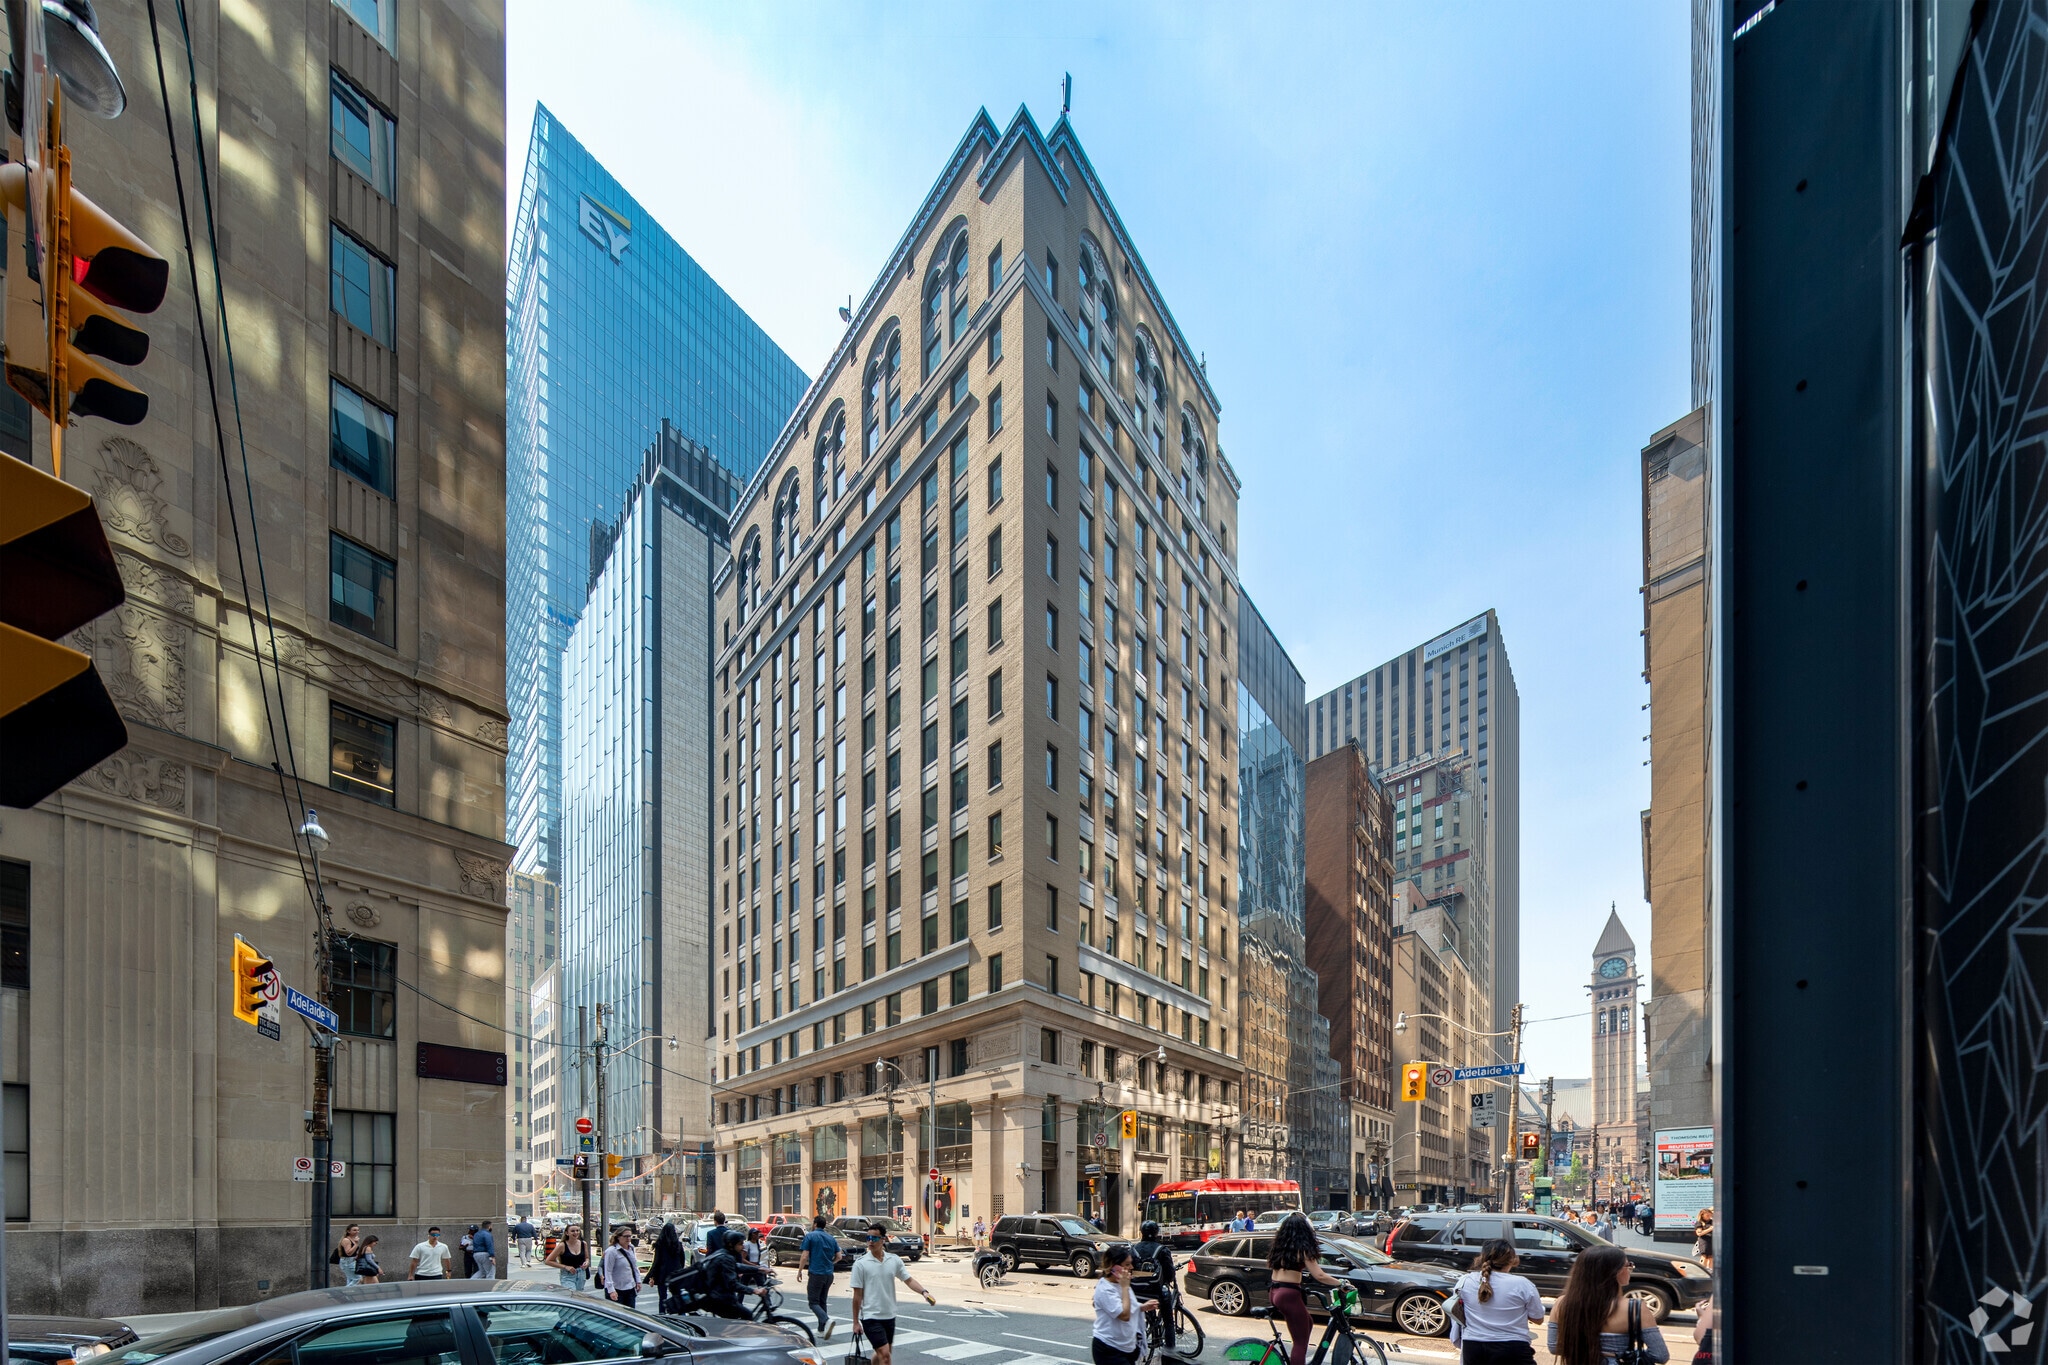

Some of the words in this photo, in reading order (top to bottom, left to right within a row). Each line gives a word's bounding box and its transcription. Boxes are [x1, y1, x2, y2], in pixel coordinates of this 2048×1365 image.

[580, 195, 631, 263] EY
[1428, 641, 1455, 658] Munich
[1456, 634, 1466, 643] RE
[290, 991, 326, 1021] Adelaide
[330, 1013, 336, 1028] W
[1458, 1067, 1502, 1078] Adelaide
[1512, 1064, 1520, 1072] W
